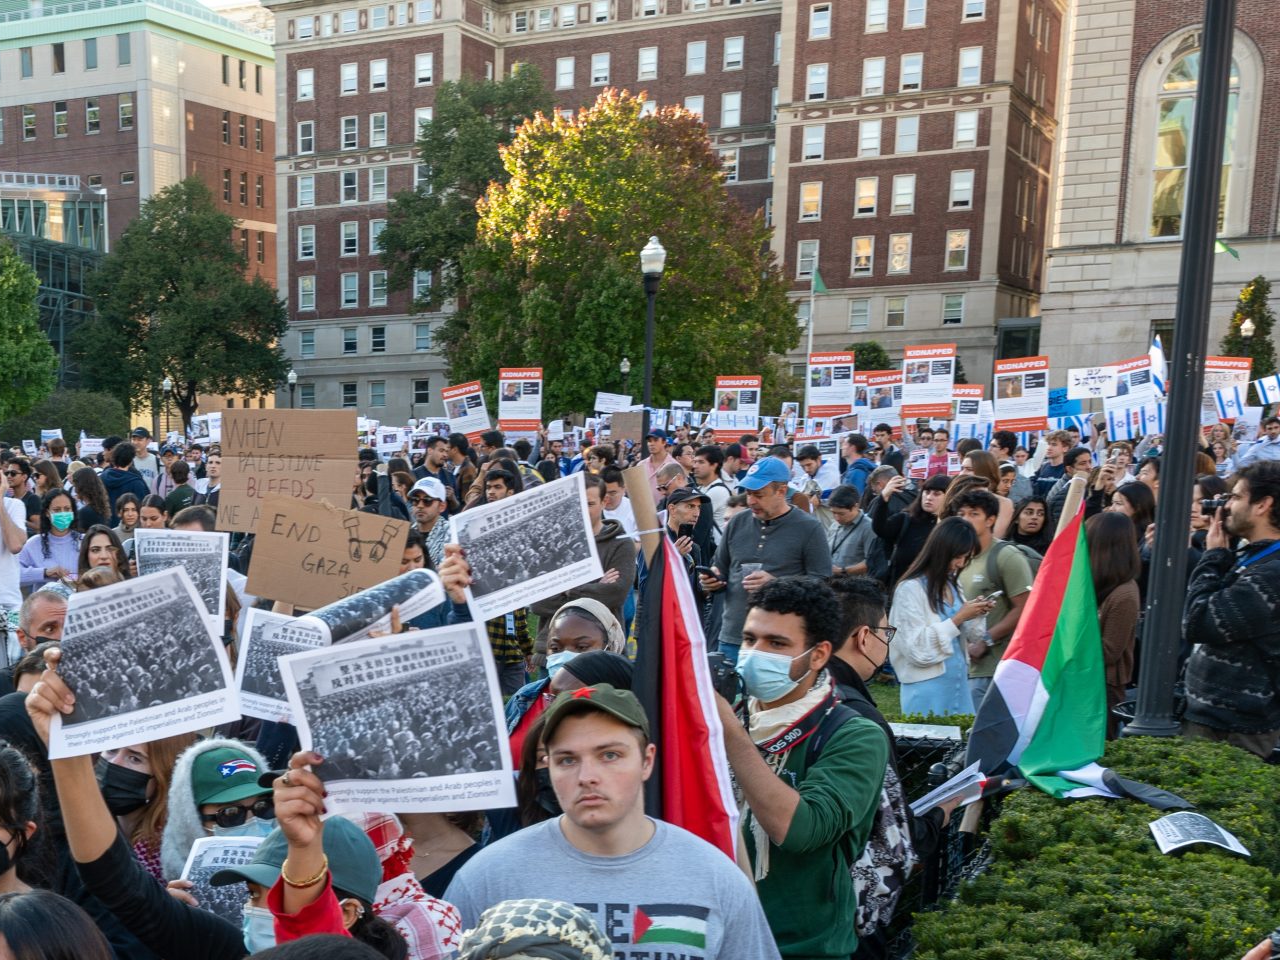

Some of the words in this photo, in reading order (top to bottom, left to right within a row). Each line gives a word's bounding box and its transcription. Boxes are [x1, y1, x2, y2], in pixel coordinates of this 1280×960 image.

[906, 348, 953, 357] KIDNAPPED
[996, 360, 1047, 371] KIDNAPPED
[869, 375, 902, 384] KIDNAPP
[443, 384, 480, 397] KIDNAPPED
[222, 418, 285, 449] WHEN
[238, 451, 325, 474] PALESTINE
[247, 477, 315, 500] BLEEDS
[220, 504, 240, 526] WE
[271, 513, 321, 543] END
[301, 552, 351, 578] GAZA
[92, 725, 117, 737] support
[129, 713, 163, 727] Palestinian
[164, 709, 176, 718] and
[177, 704, 193, 714] Arab
[194, 700, 218, 711] peoples
[136, 726, 145, 734] US
[146, 718, 183, 731] imperialism
[184, 714, 196, 722] and
[784, 728, 803, 743] 90D
[392, 786, 428, 795] Palestinian
[430, 783, 443, 792] and
[464, 779, 493, 790] peoples
[412, 794, 449, 804] imperialism
[451, 791, 465, 800] and
